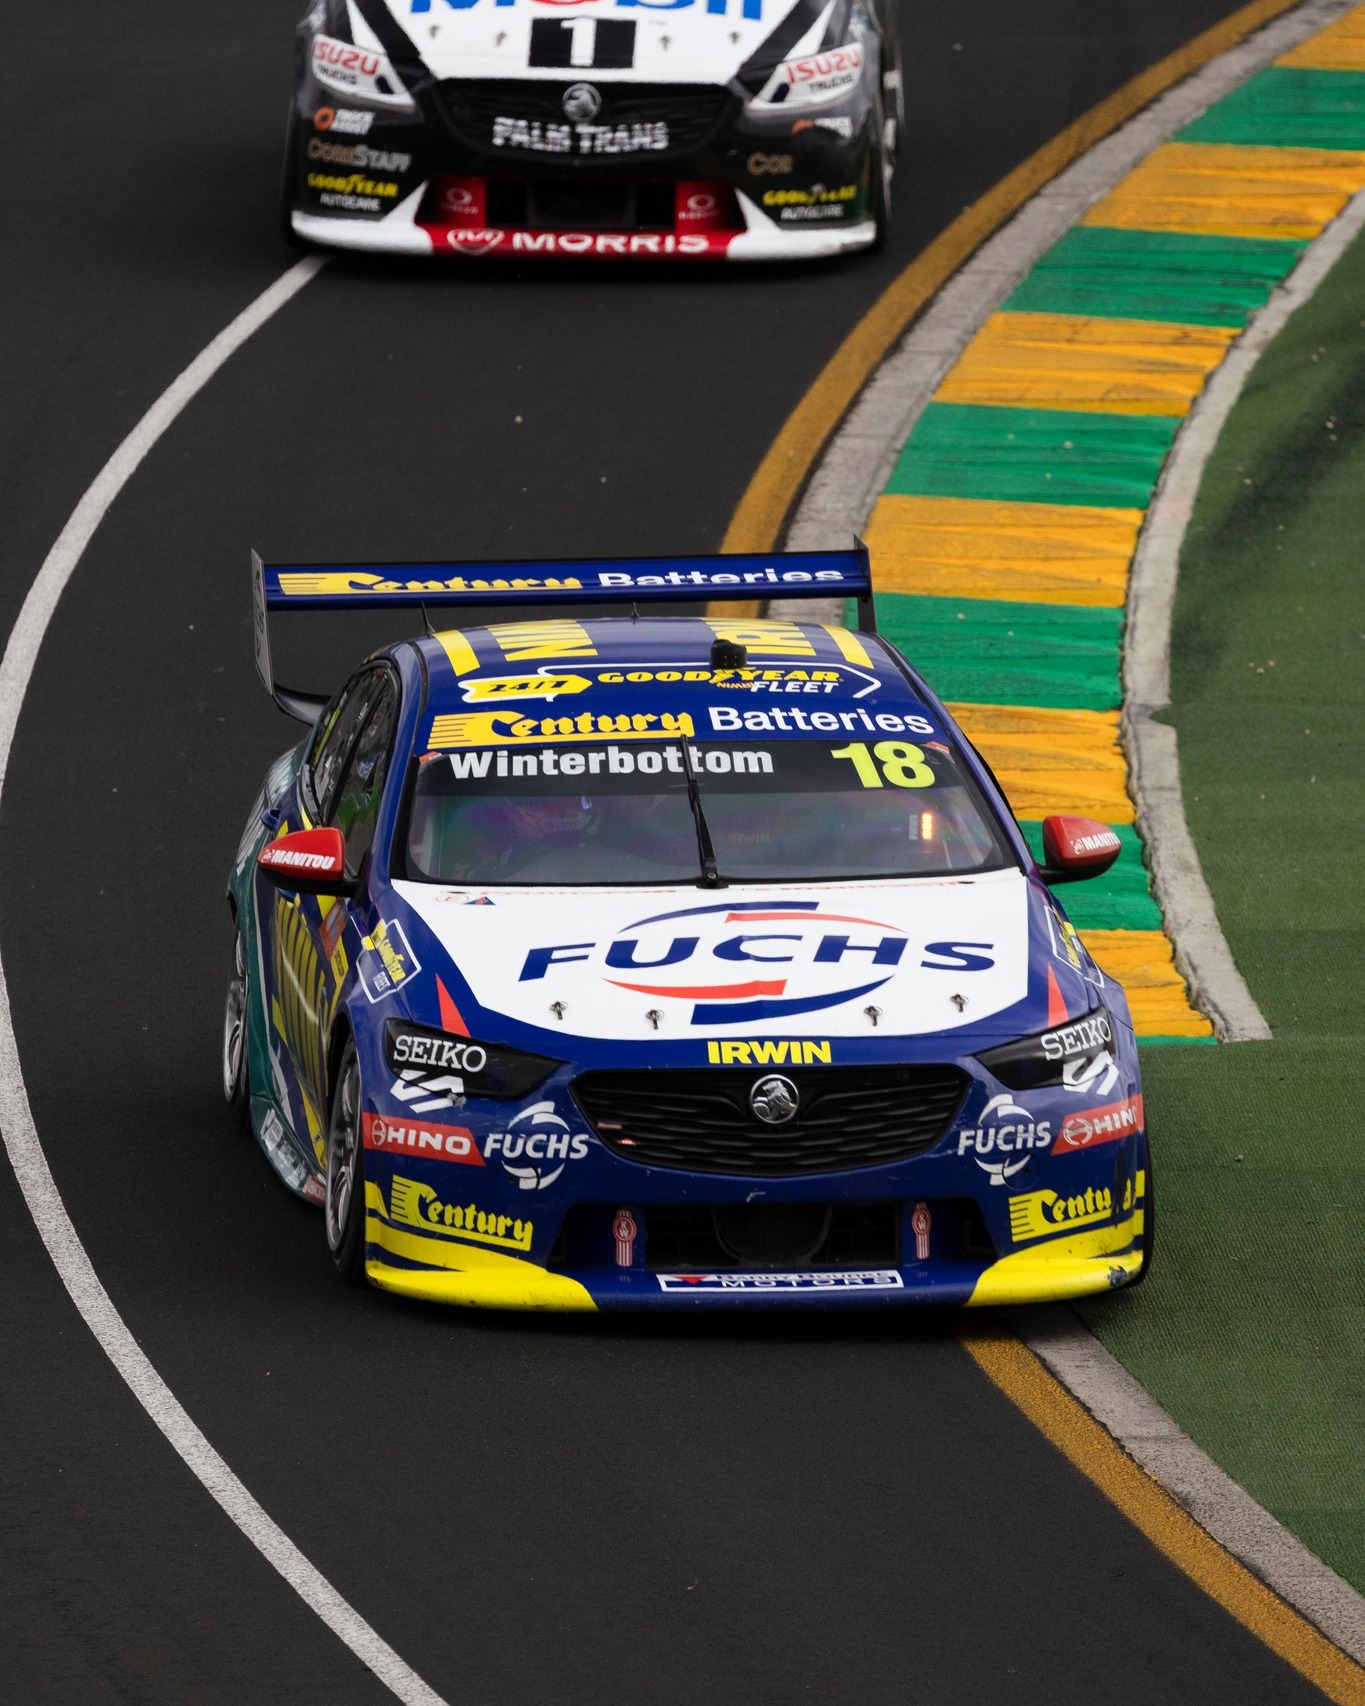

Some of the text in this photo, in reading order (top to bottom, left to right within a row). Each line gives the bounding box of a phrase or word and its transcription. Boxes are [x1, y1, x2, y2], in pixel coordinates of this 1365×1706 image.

[562, 17, 597, 66] 1
[513, 232, 710, 253] MORRIS
[598, 567, 845, 588] Batteries
[597, 667, 842, 684] GOODYEAR
[750, 680, 839, 693] FLEET
[426, 706, 935, 749] Century Batteries
[450, 746, 774, 780] Winterbottom
[830, 740, 936, 789] 18
[271, 849, 335, 870] MANITOU
[518, 934, 996, 982] FUCHS
[393, 1035, 487, 1073] SEIKO
[707, 1040, 832, 1064] IRWIN
[1040, 1016, 1112, 1061] SEIKO
[387, 1127, 471, 1155] HINO
[484, 1133, 589, 1159] FUCHS
[957, 1121, 1051, 1156] FUCHS
[390, 1174, 534, 1252] Century
[721, 1278, 893, 1288] MOTORS
